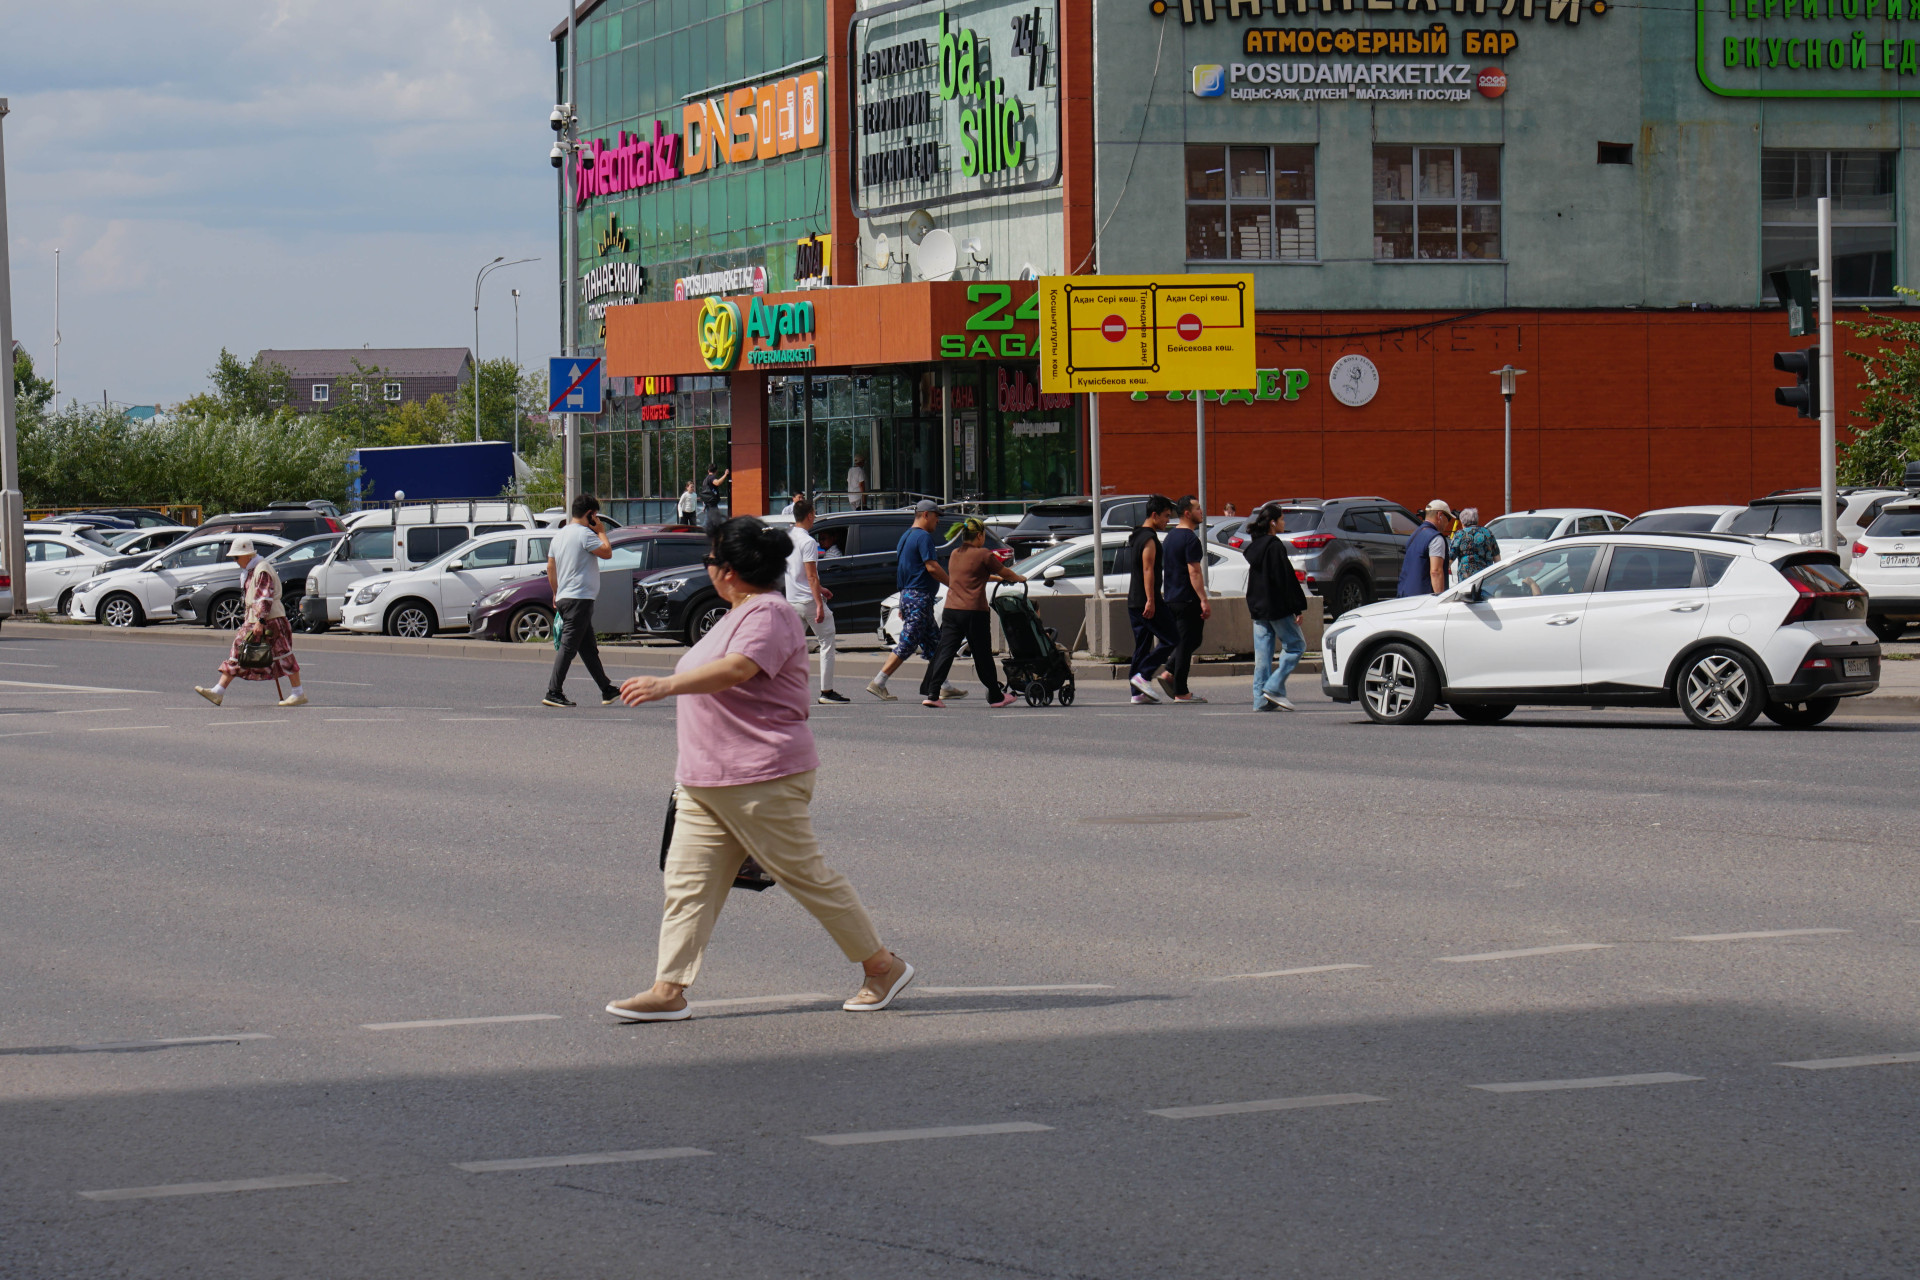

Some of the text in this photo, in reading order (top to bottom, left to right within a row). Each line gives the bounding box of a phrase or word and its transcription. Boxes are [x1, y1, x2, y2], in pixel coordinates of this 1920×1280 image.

[1247, 26, 1516, 54] АТМОСФЕРНЫЙ БАР
[1725, 31, 1867, 69] ВКУСНОЙ
[861, 39, 929, 85] ДӘМХАНА
[1230, 63, 1472, 85] POSUDAMARKET.KZ
[1230, 88, 1299, 101] ЫДЫС-АЯҚ
[1355, 88, 1413, 100] МАГАЗИН
[1417, 89, 1471, 101] ПОСУДЫ
[862, 91, 930, 135] ТЕРРИТОРИЯ
[683, 86, 757, 176] DNS
[862, 137, 912, 187] ВКУСНОЙ
[584, 263, 640, 304] ПАНАЕХАЛИ
[686, 266, 754, 297] POSUDAMARKET.KZ
[1166, 295, 1187, 303] Ақан
[1189, 294, 1208, 303] Сері
[1074, 296, 1095, 304] Ақан
[1097, 295, 1117, 304] Сері
[746, 296, 814, 347] Ayan
[1167, 344, 1213, 352] Бейсекова
[998, 366, 1034, 412] Bella
[641, 404, 670, 421] BURGER
